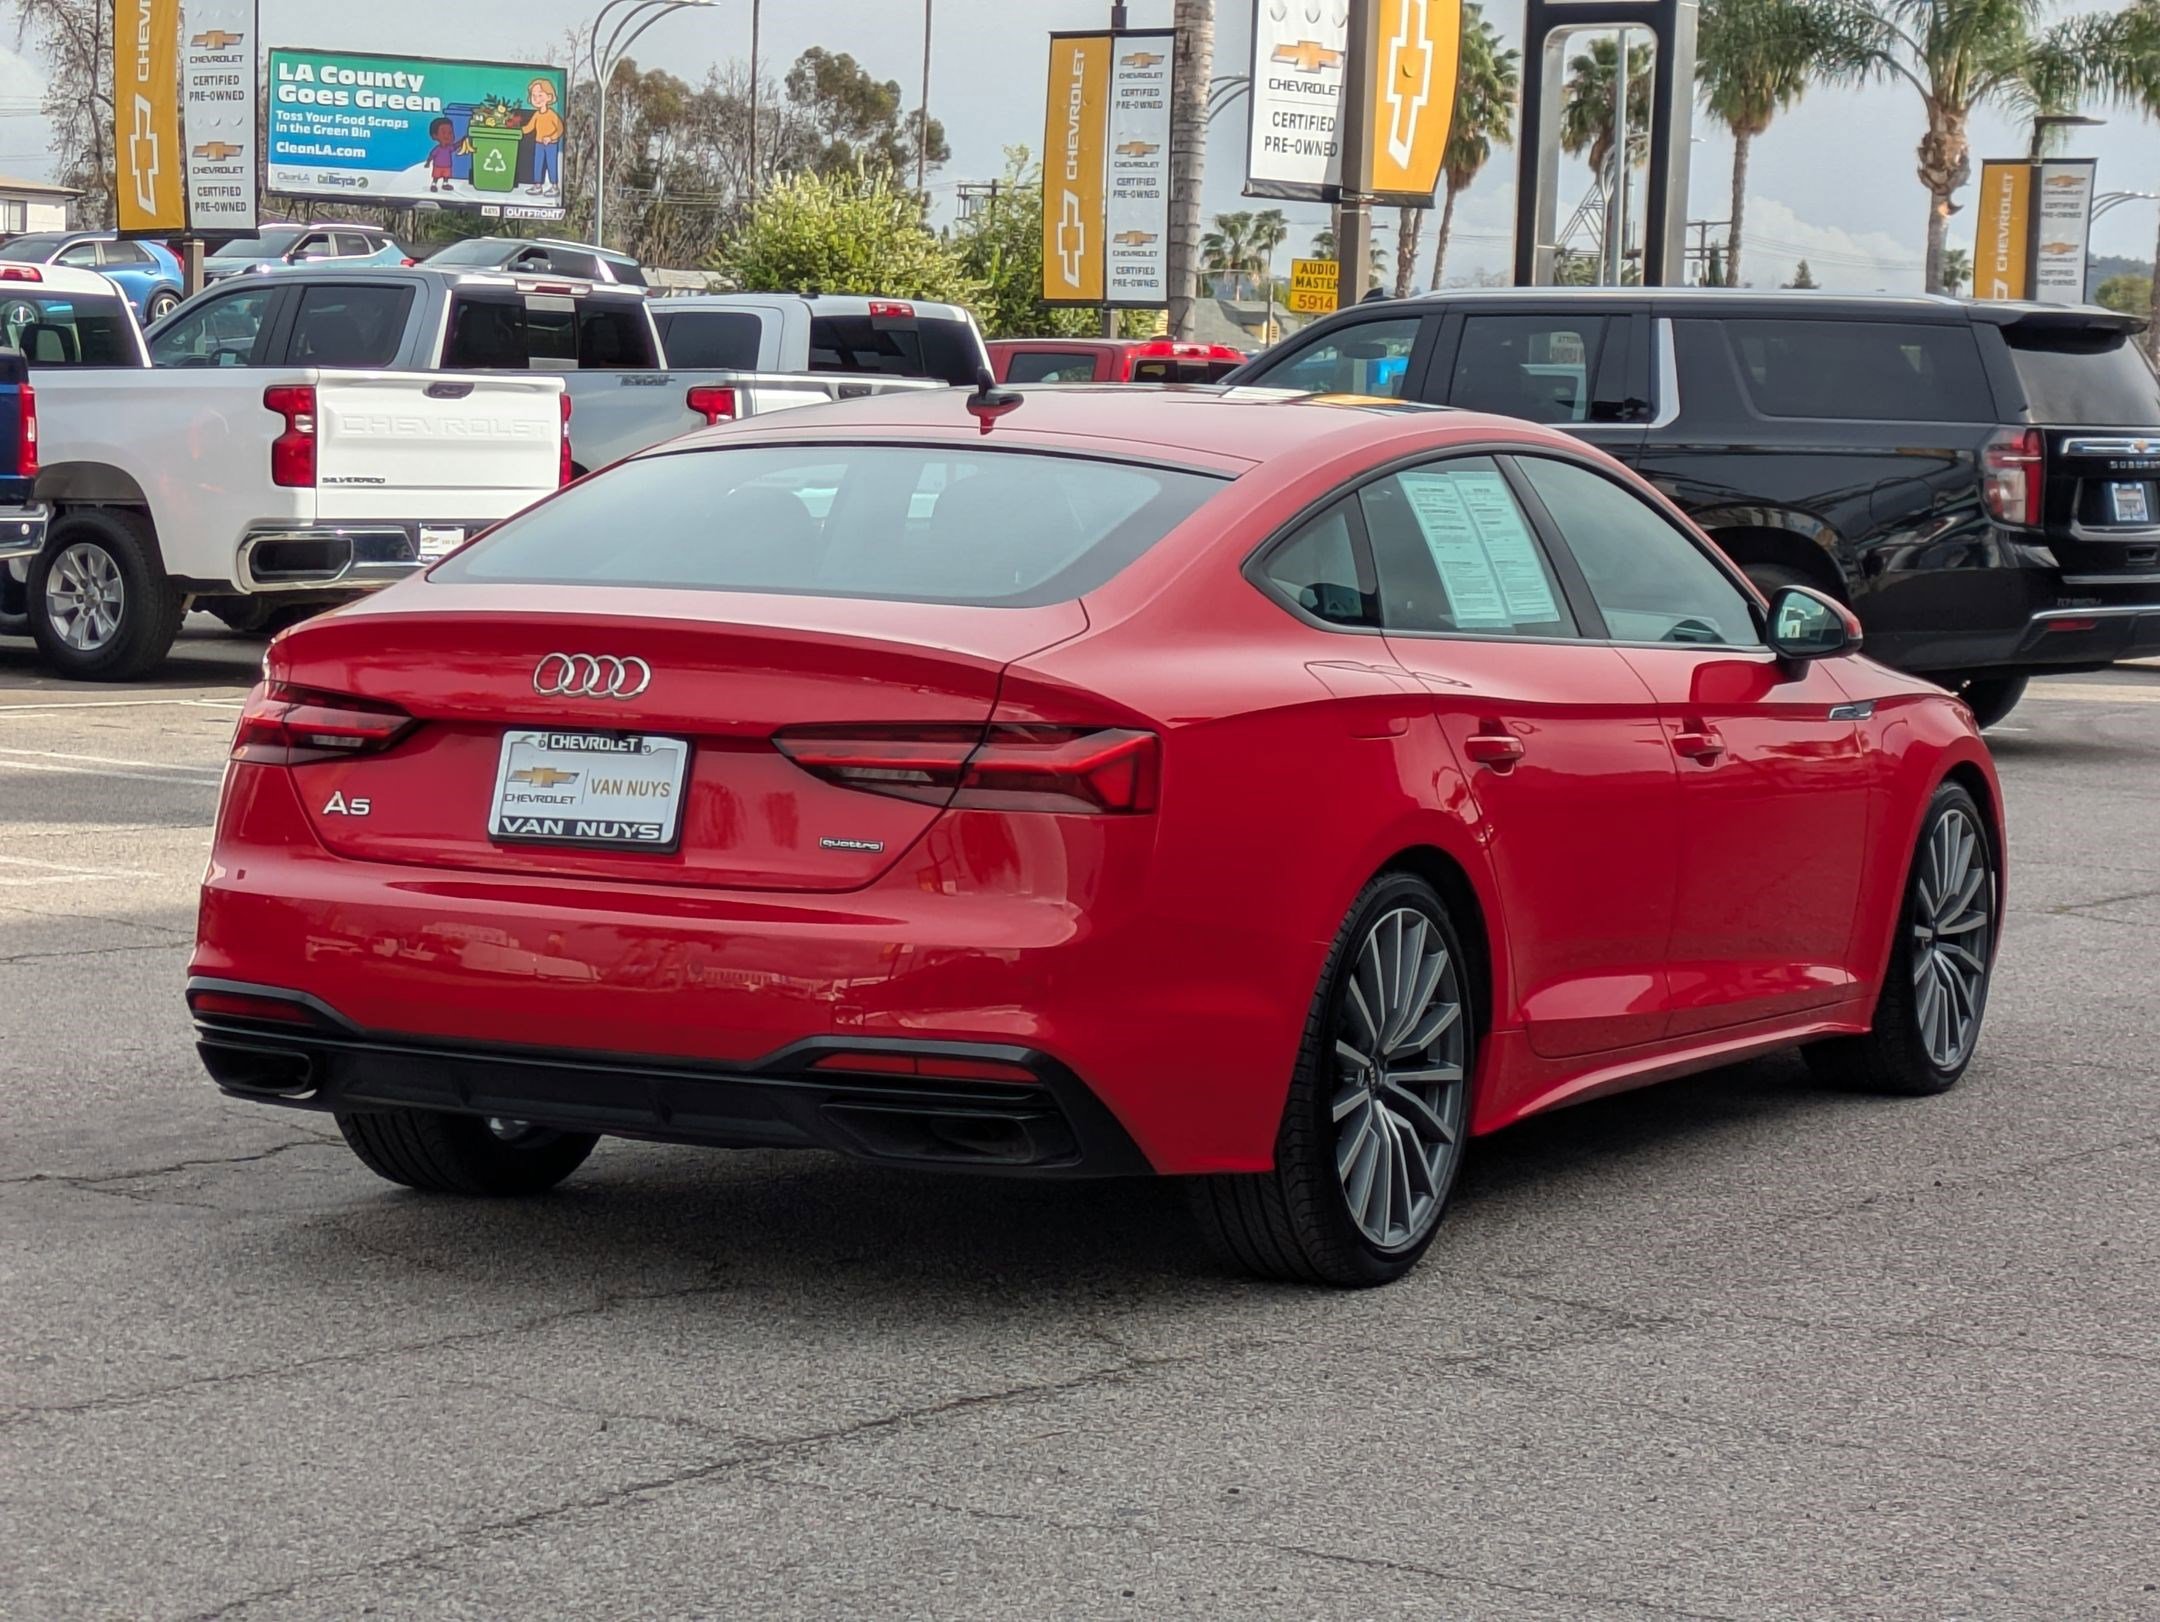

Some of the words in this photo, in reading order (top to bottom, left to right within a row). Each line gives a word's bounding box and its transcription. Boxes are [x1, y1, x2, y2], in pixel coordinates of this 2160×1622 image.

[190, 54, 244, 64] CHEVROLET
[193, 75, 239, 86] CERTIFIED
[278, 63, 315, 82] LA
[320, 65, 425, 93] County
[1121, 88, 1160, 97] CERTIFIED
[1268, 77, 1344, 96] CHEVROLET
[189, 90, 244, 101] PRE-OWNED
[278, 84, 349, 106] Goes
[355, 89, 441, 112] Green
[1116, 100, 1163, 109] PRE-OWNED
[276, 110, 303, 121] Toss
[305, 111, 333, 123] Your
[335, 114, 365, 125] Food
[368, 116, 409, 130] Scraps
[1066, 48, 1085, 181] CHEVROLET
[1272, 111, 1336, 131] CERTIFIED
[290, 122, 310, 134] the
[313, 124, 348, 136] Green
[351, 127, 371, 138] Bin
[276, 141, 366, 158] CleanLA.com
[1264, 135, 1338, 158] PRE-OWNED
[193, 166, 244, 175] CHEVROLET
[1116, 177, 1156, 186] CERTIFIED
[197, 186, 241, 197] CERTIFIED
[1113, 189, 1160, 199] PRE-OWNED
[195, 201, 246, 212] PRE-OWNED
[506, 208, 561, 219] OUTFRONT
[1996, 172, 2015, 272] CHEVROLET
[1115, 266, 1155, 275] CERTIFIED
[1300, 262, 1336, 276] AUDIO
[1112, 278, 1159, 288] PRE-OWNED
[1297, 294, 1334, 310] 5914
[342, 415, 550, 437] CHEVROLET
[322, 477, 386, 485] SILVERADO
[550, 734, 639, 752] CHEVROLET
[591, 778, 622, 796] VAN
[626, 780, 671, 798] NUYS
[322, 790, 371, 816] A5
[504, 793, 576, 805] CHEVROLET
[501, 817, 564, 835] VAN
[575, 821, 660, 840] NUYS
[822, 839, 880, 850] quattro
